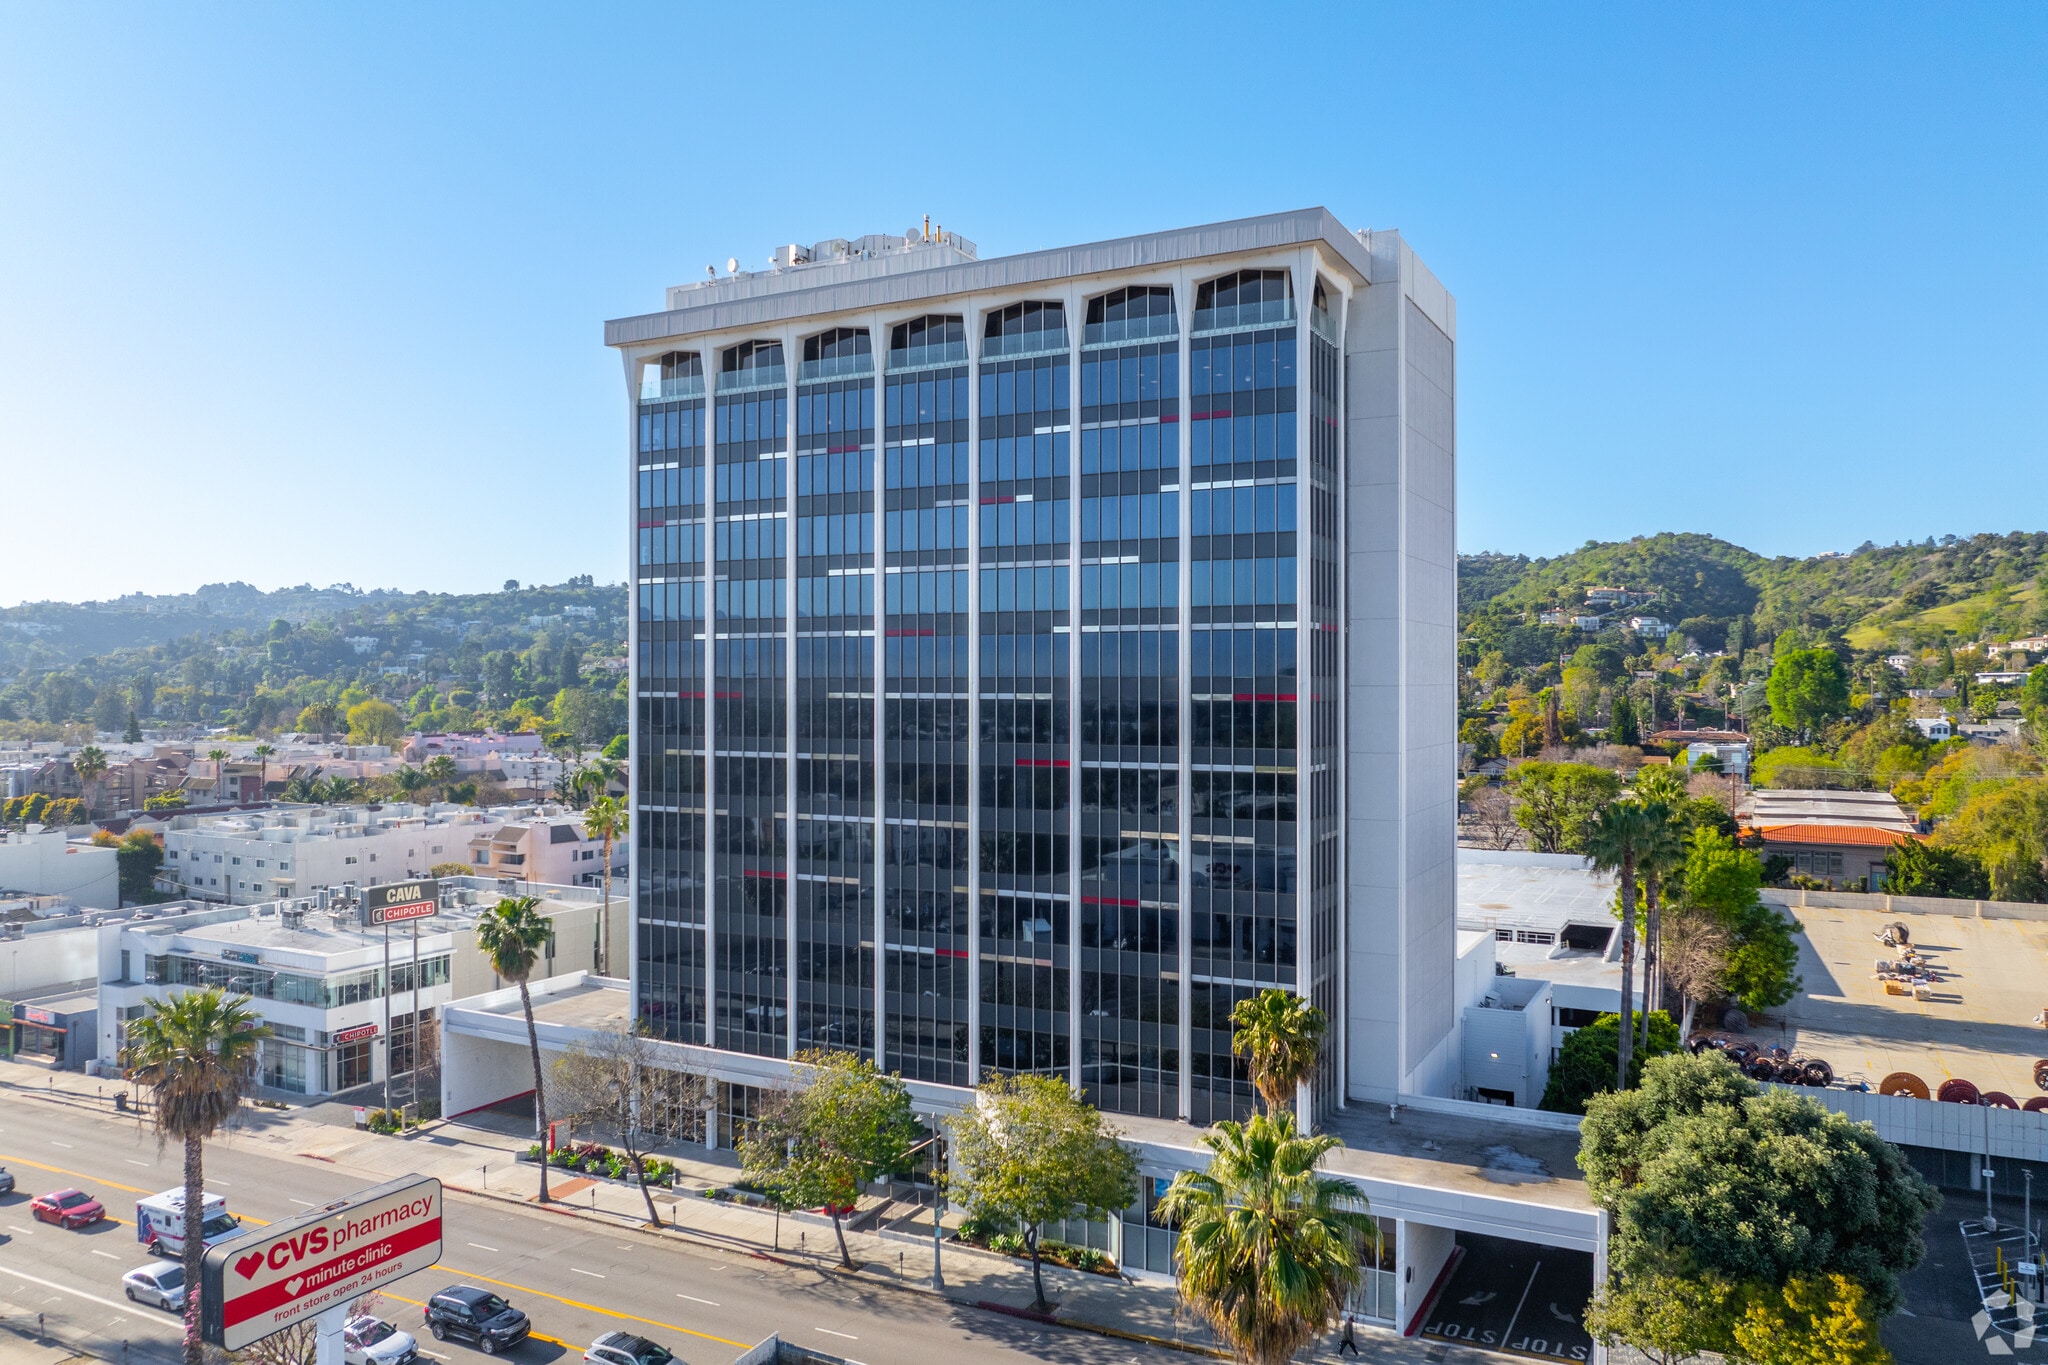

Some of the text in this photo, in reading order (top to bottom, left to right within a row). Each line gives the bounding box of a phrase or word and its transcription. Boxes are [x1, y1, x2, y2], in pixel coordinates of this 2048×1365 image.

[386, 885, 421, 903] CAVA
[387, 903, 432, 919] CHIPOTLE
[344, 1026, 378, 1040] CHIPOTLE
[266, 1195, 433, 1271] CVS pharmacy
[306, 1242, 393, 1288] minute clinic
[274, 1262, 403, 1322] front store open 24 hours
[1424, 1321, 1498, 1344] STOP
[1511, 1336, 1588, 1360] STOP
